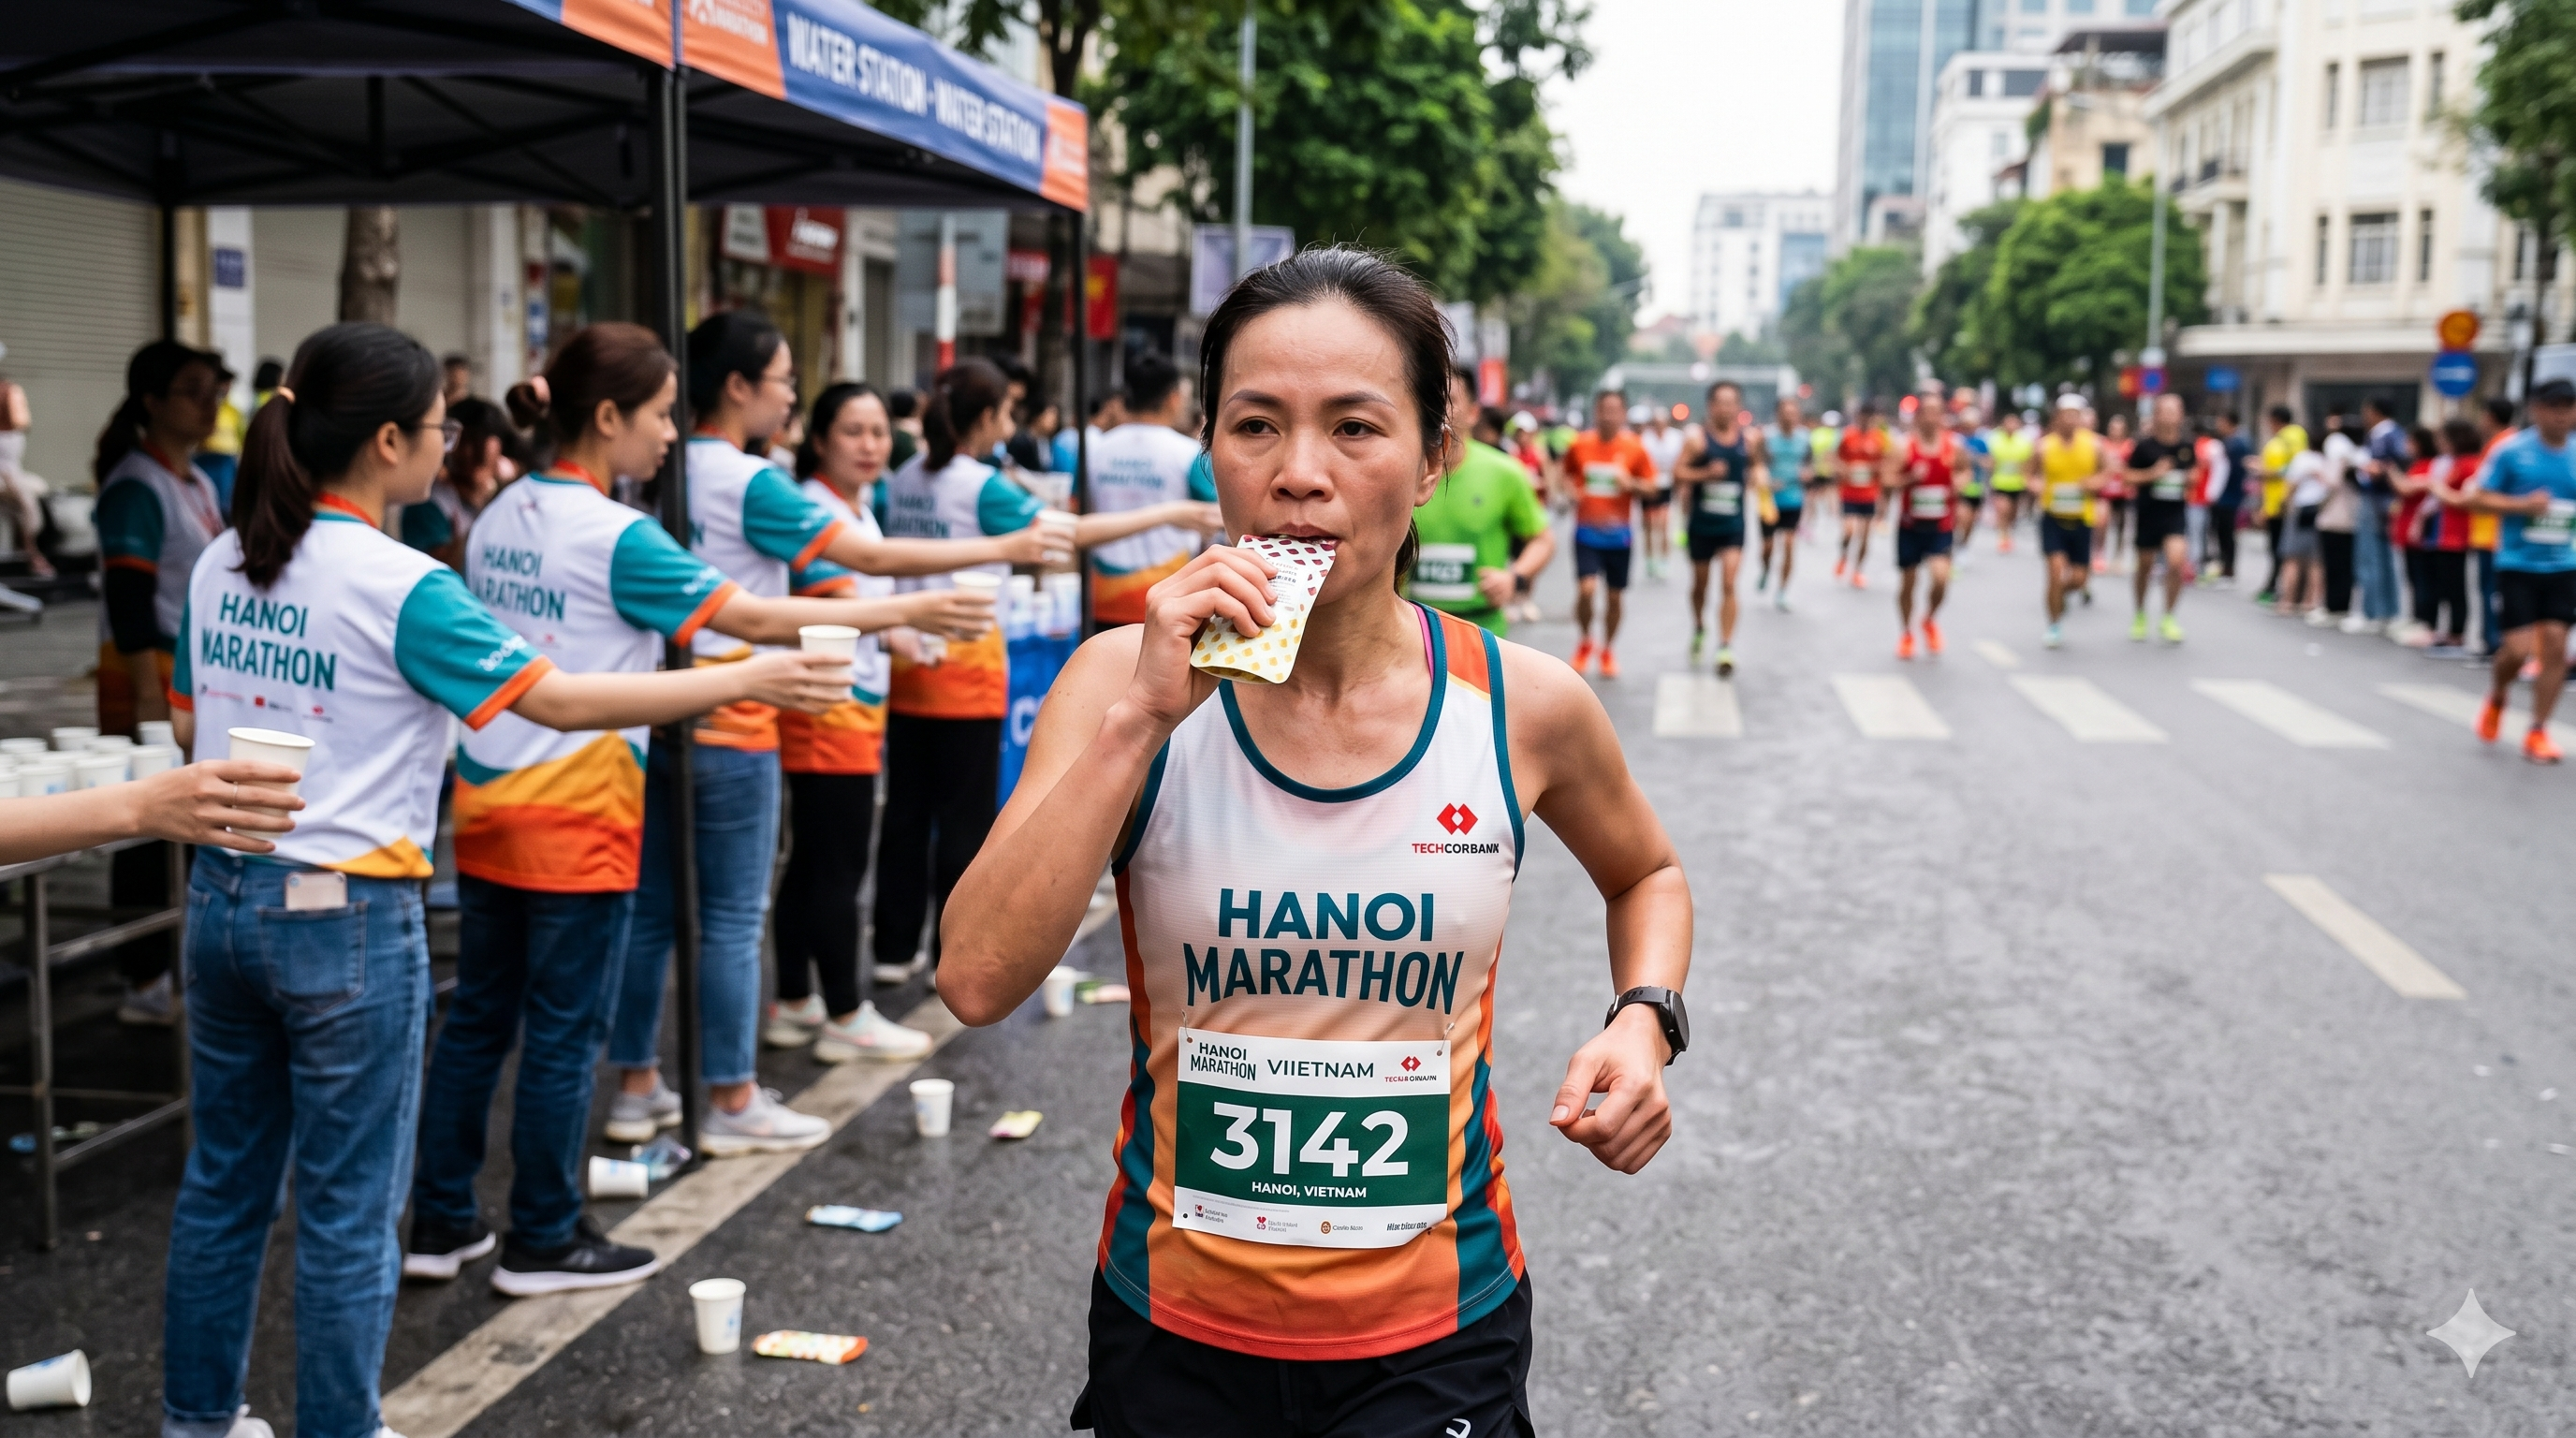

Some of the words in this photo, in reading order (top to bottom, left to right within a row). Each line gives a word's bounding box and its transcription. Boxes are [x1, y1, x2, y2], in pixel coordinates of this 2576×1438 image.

[786, 11, 856, 89] WATER
[856, 43, 928, 117] STATION
[219, 593, 308, 638] HANOI
[201, 627, 337, 691] MARATHON
[1218, 888, 1434, 942] HANOI
[1183, 943, 1464, 1015] MARATHON
[1191, 1054, 1256, 1081] MARATHON
[1199, 1042, 1247, 1061] HANOI
[1267, 1059, 1374, 1078] VIIETNAM
[1209, 1102, 1409, 1178] 3142
[1251, 1181, 1301, 1198] HANOI,
[1304, 1184, 1367, 1199] VIETNAM
